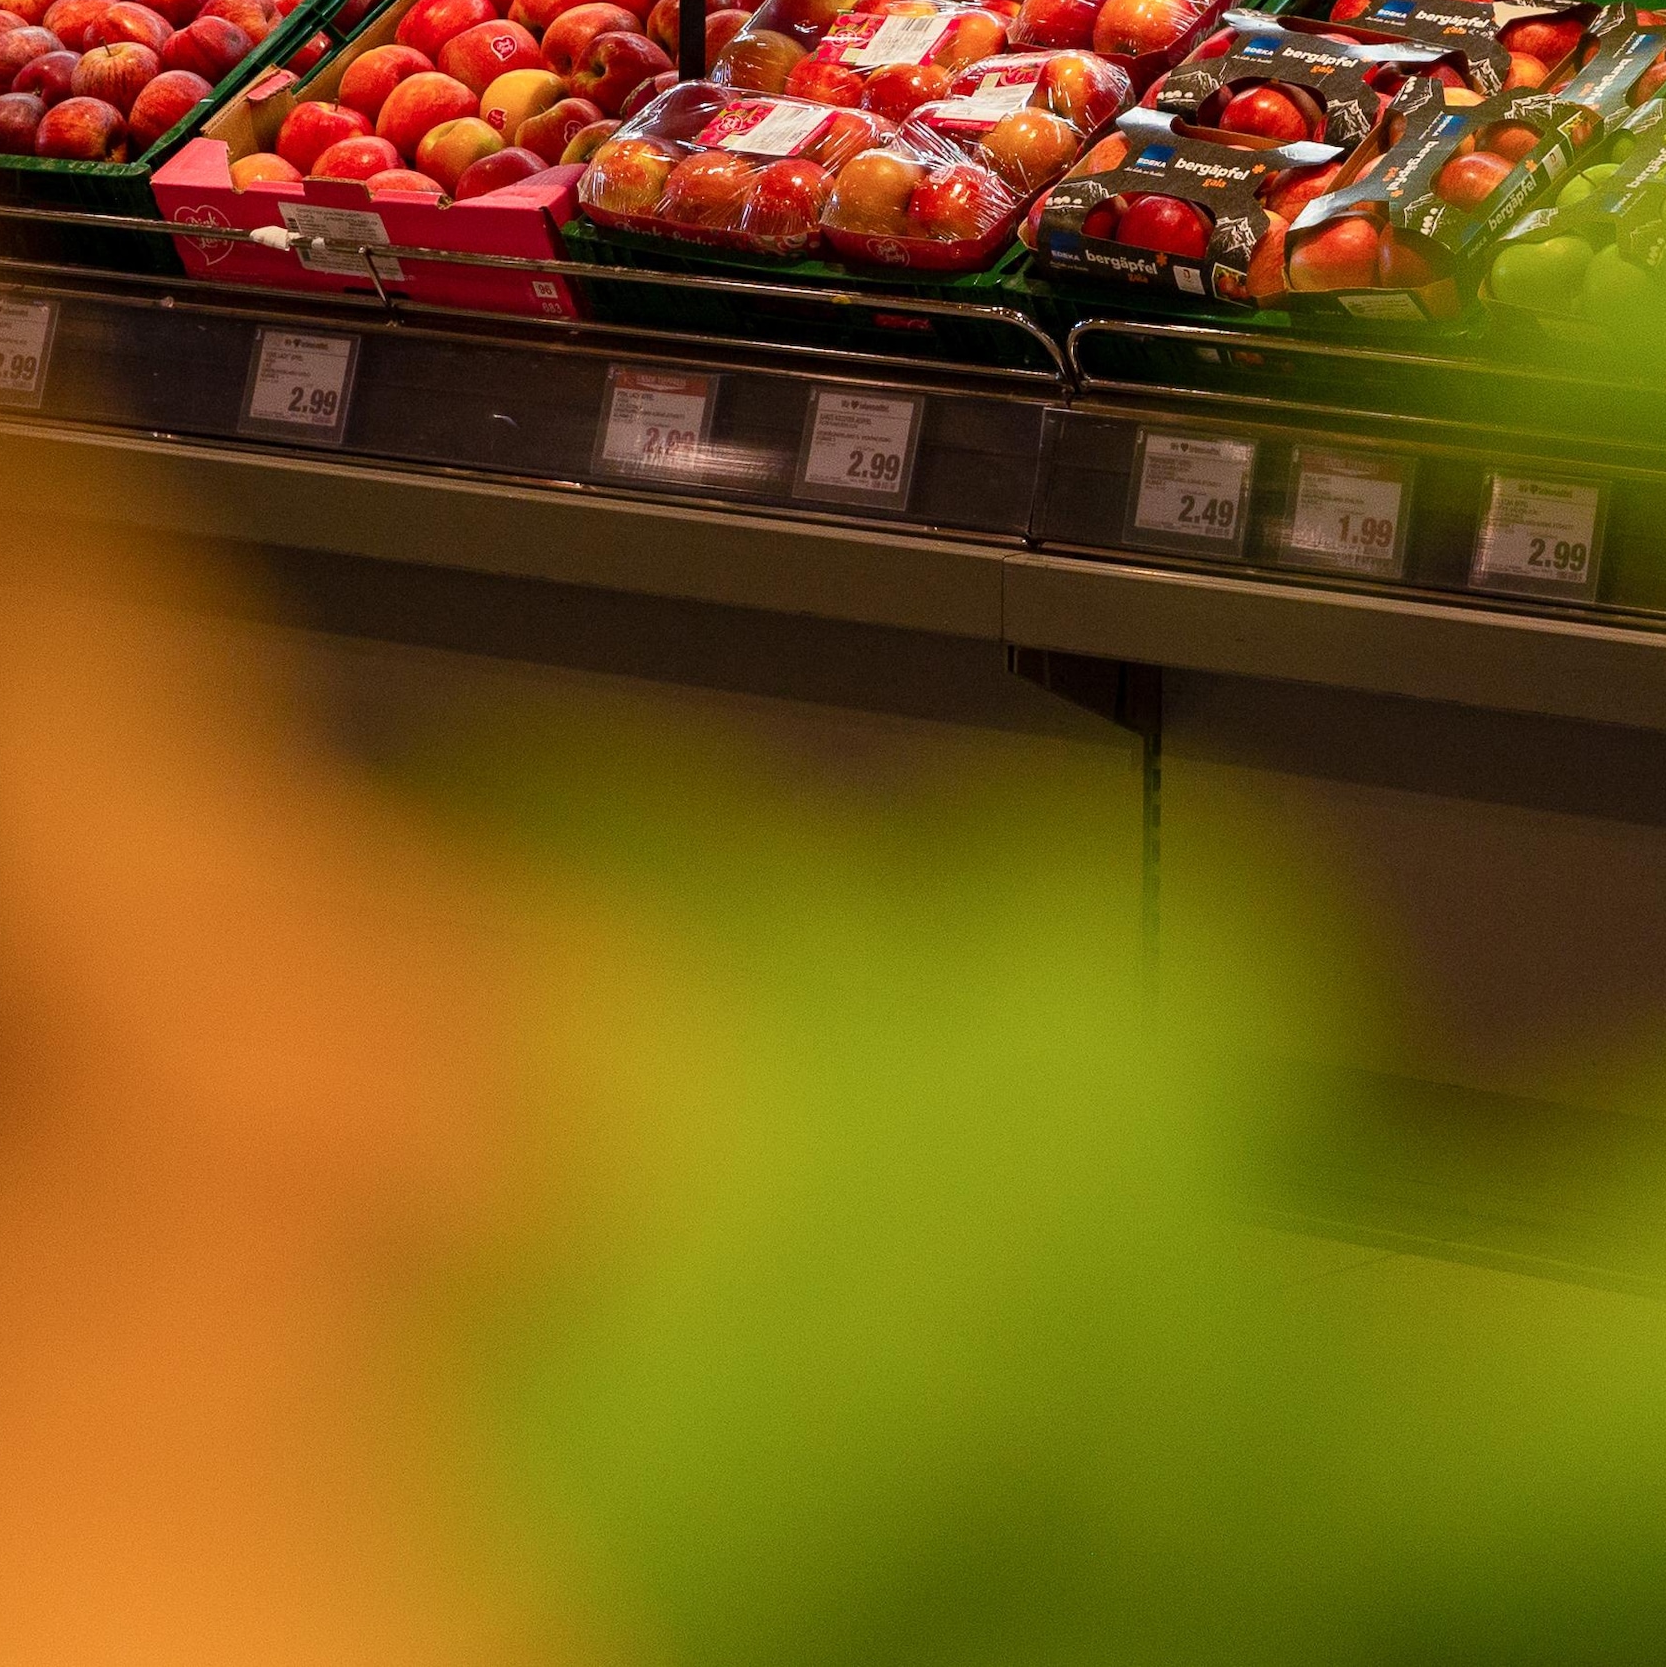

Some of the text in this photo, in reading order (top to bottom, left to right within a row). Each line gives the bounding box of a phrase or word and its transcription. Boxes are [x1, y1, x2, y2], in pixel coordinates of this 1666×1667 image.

[1415, 9, 1490, 29] bergäpfel
[1282, 46, 1359, 69] bergäpfel
[1136, 157, 1251, 182] EDEKA bergäpfel
[1201, 176, 1228, 189] gala
[1487, 174, 1538, 233] bergäpfel
[1085, 249, 1159, 276] bergäpfel
[538, 284, 553, 295] 96
[542, 302, 563, 314] 683
[288, 386, 338, 416] 2.99
[846, 449, 901, 482] 2.99
[1177, 495, 1235, 528] 2.49
[1338, 514, 1393, 548] 1.99
[1528, 537, 1586, 572] 2.99
